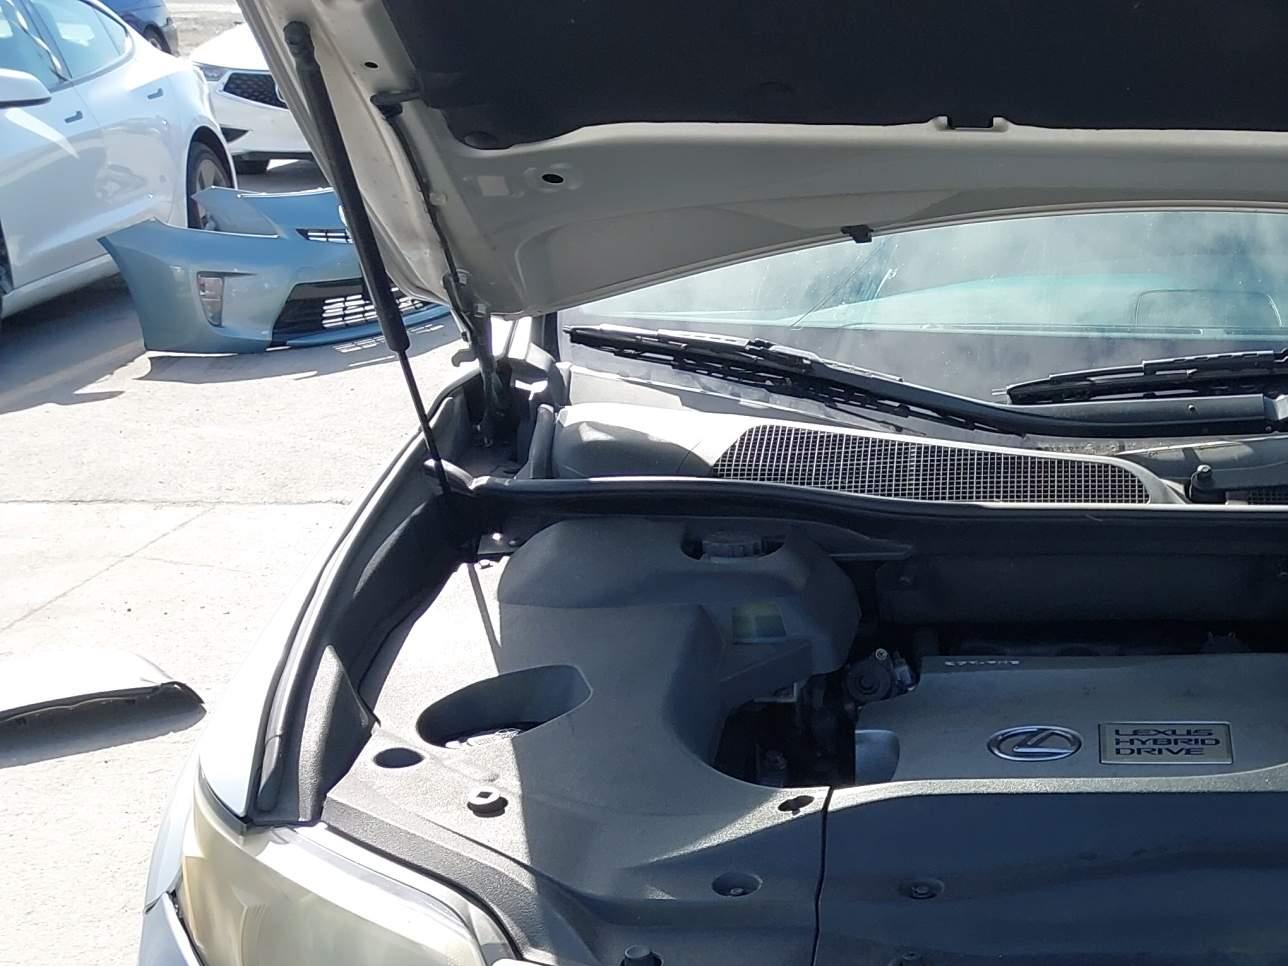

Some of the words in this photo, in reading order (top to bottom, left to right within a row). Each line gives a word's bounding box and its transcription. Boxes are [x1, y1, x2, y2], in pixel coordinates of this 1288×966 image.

[1114, 728, 1214, 737] LEXUS
[1114, 737, 1221, 746] HYBRID
[1114, 747, 1206, 756] DRIVE
